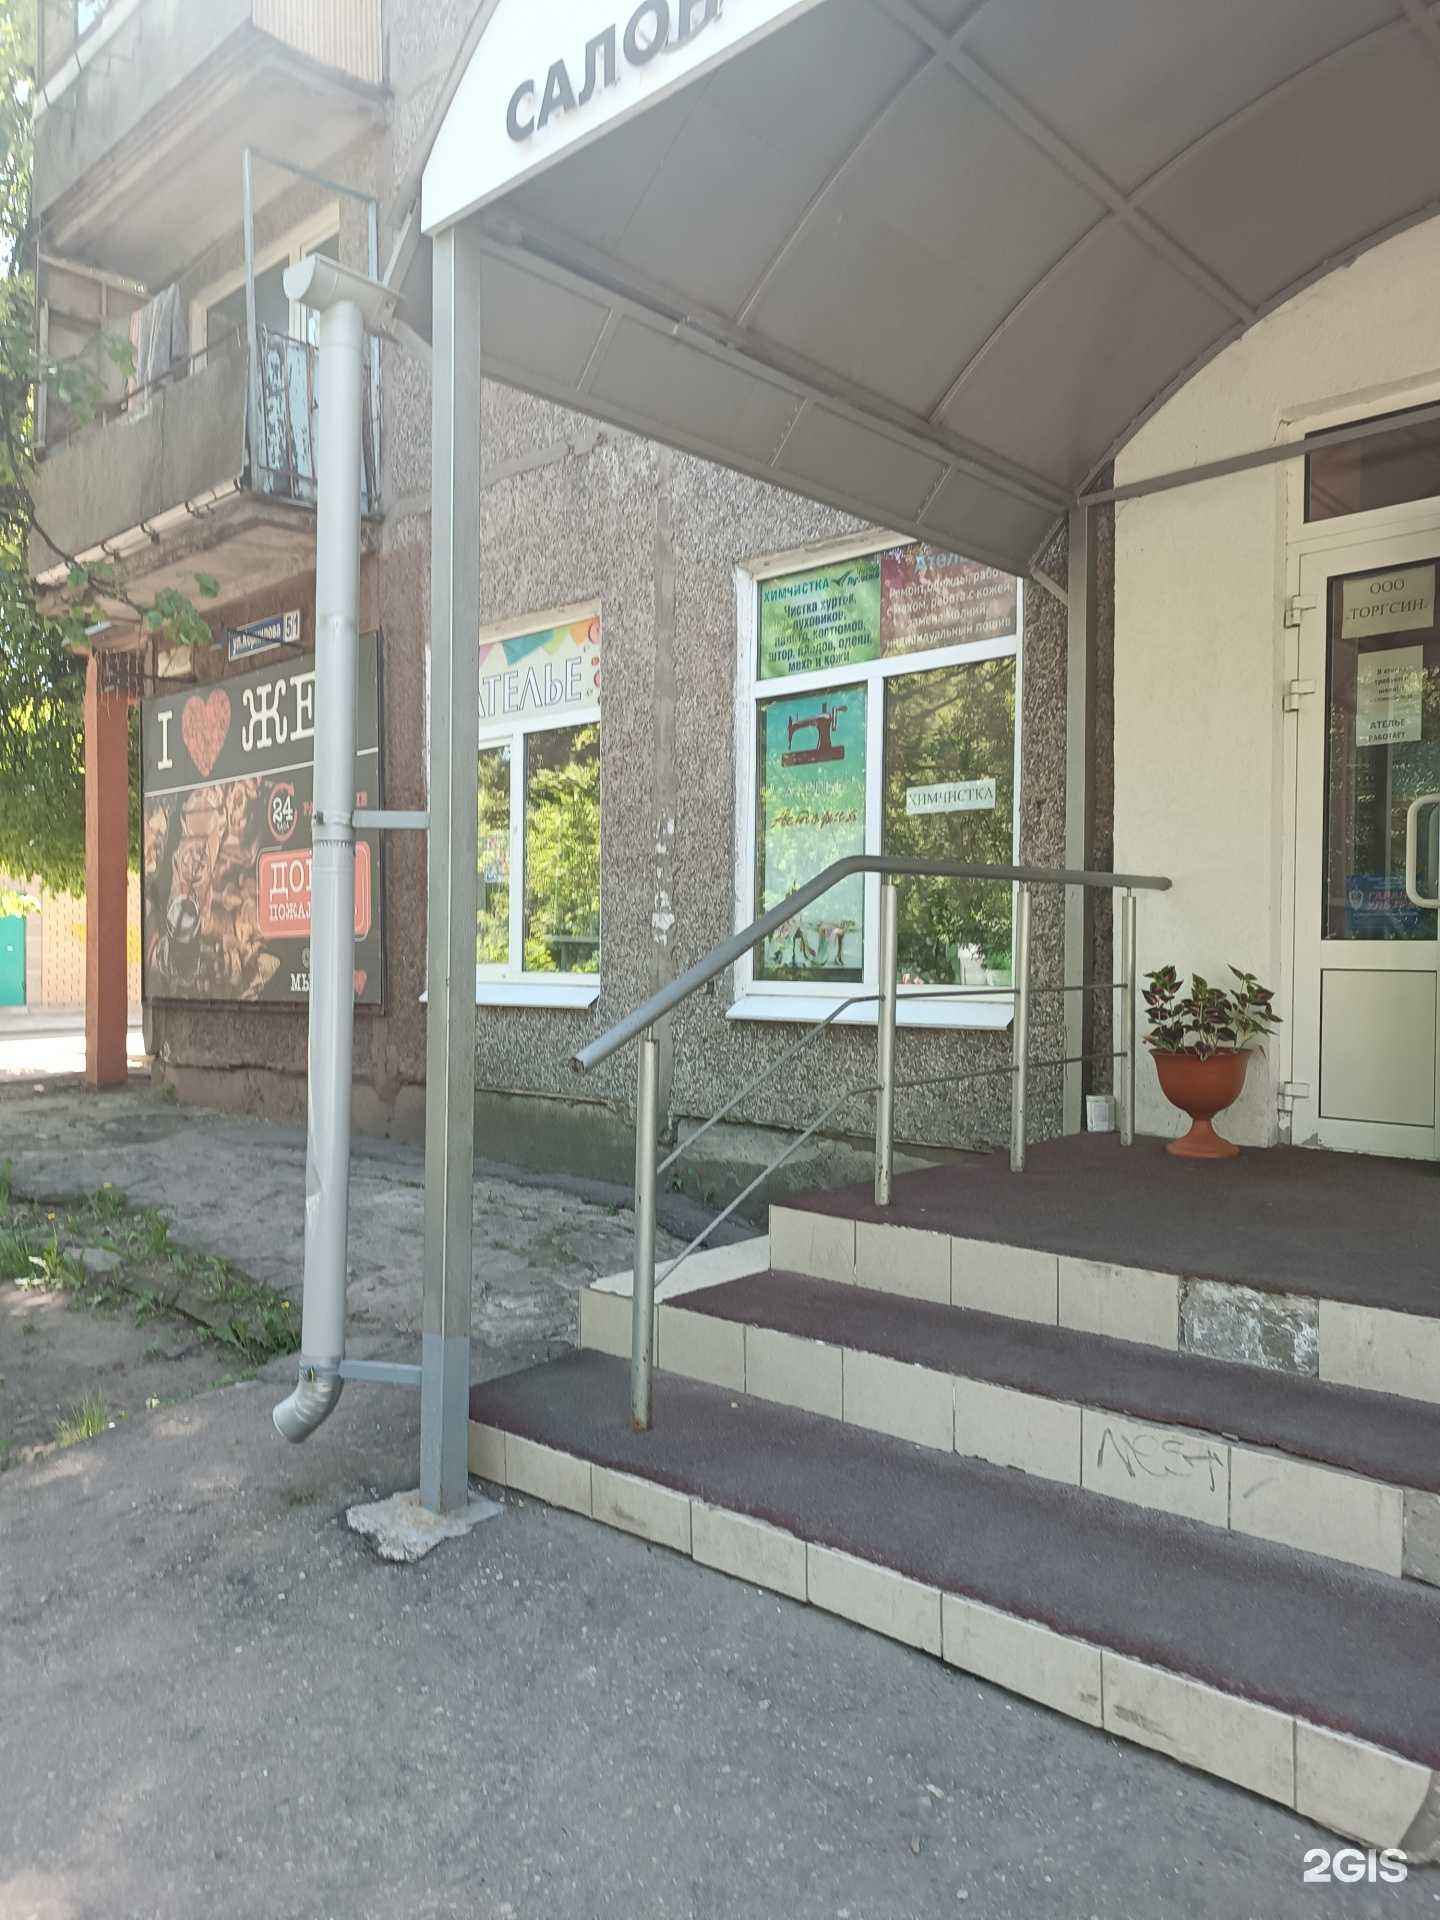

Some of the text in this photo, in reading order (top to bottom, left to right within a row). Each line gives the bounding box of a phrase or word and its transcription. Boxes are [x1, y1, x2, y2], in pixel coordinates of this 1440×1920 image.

[764, 578, 829, 602] ХИМЧИСТКА
[1369, 578, 1405, 594] ООО
[784, 602, 817, 618] Чистка
[1369, 719, 1406, 730] АТЕЛЬЕ
[158, 710, 173, 770] I
[910, 787, 993, 808] ХИМЧИСТКА
[273, 796, 293, 823] 24
